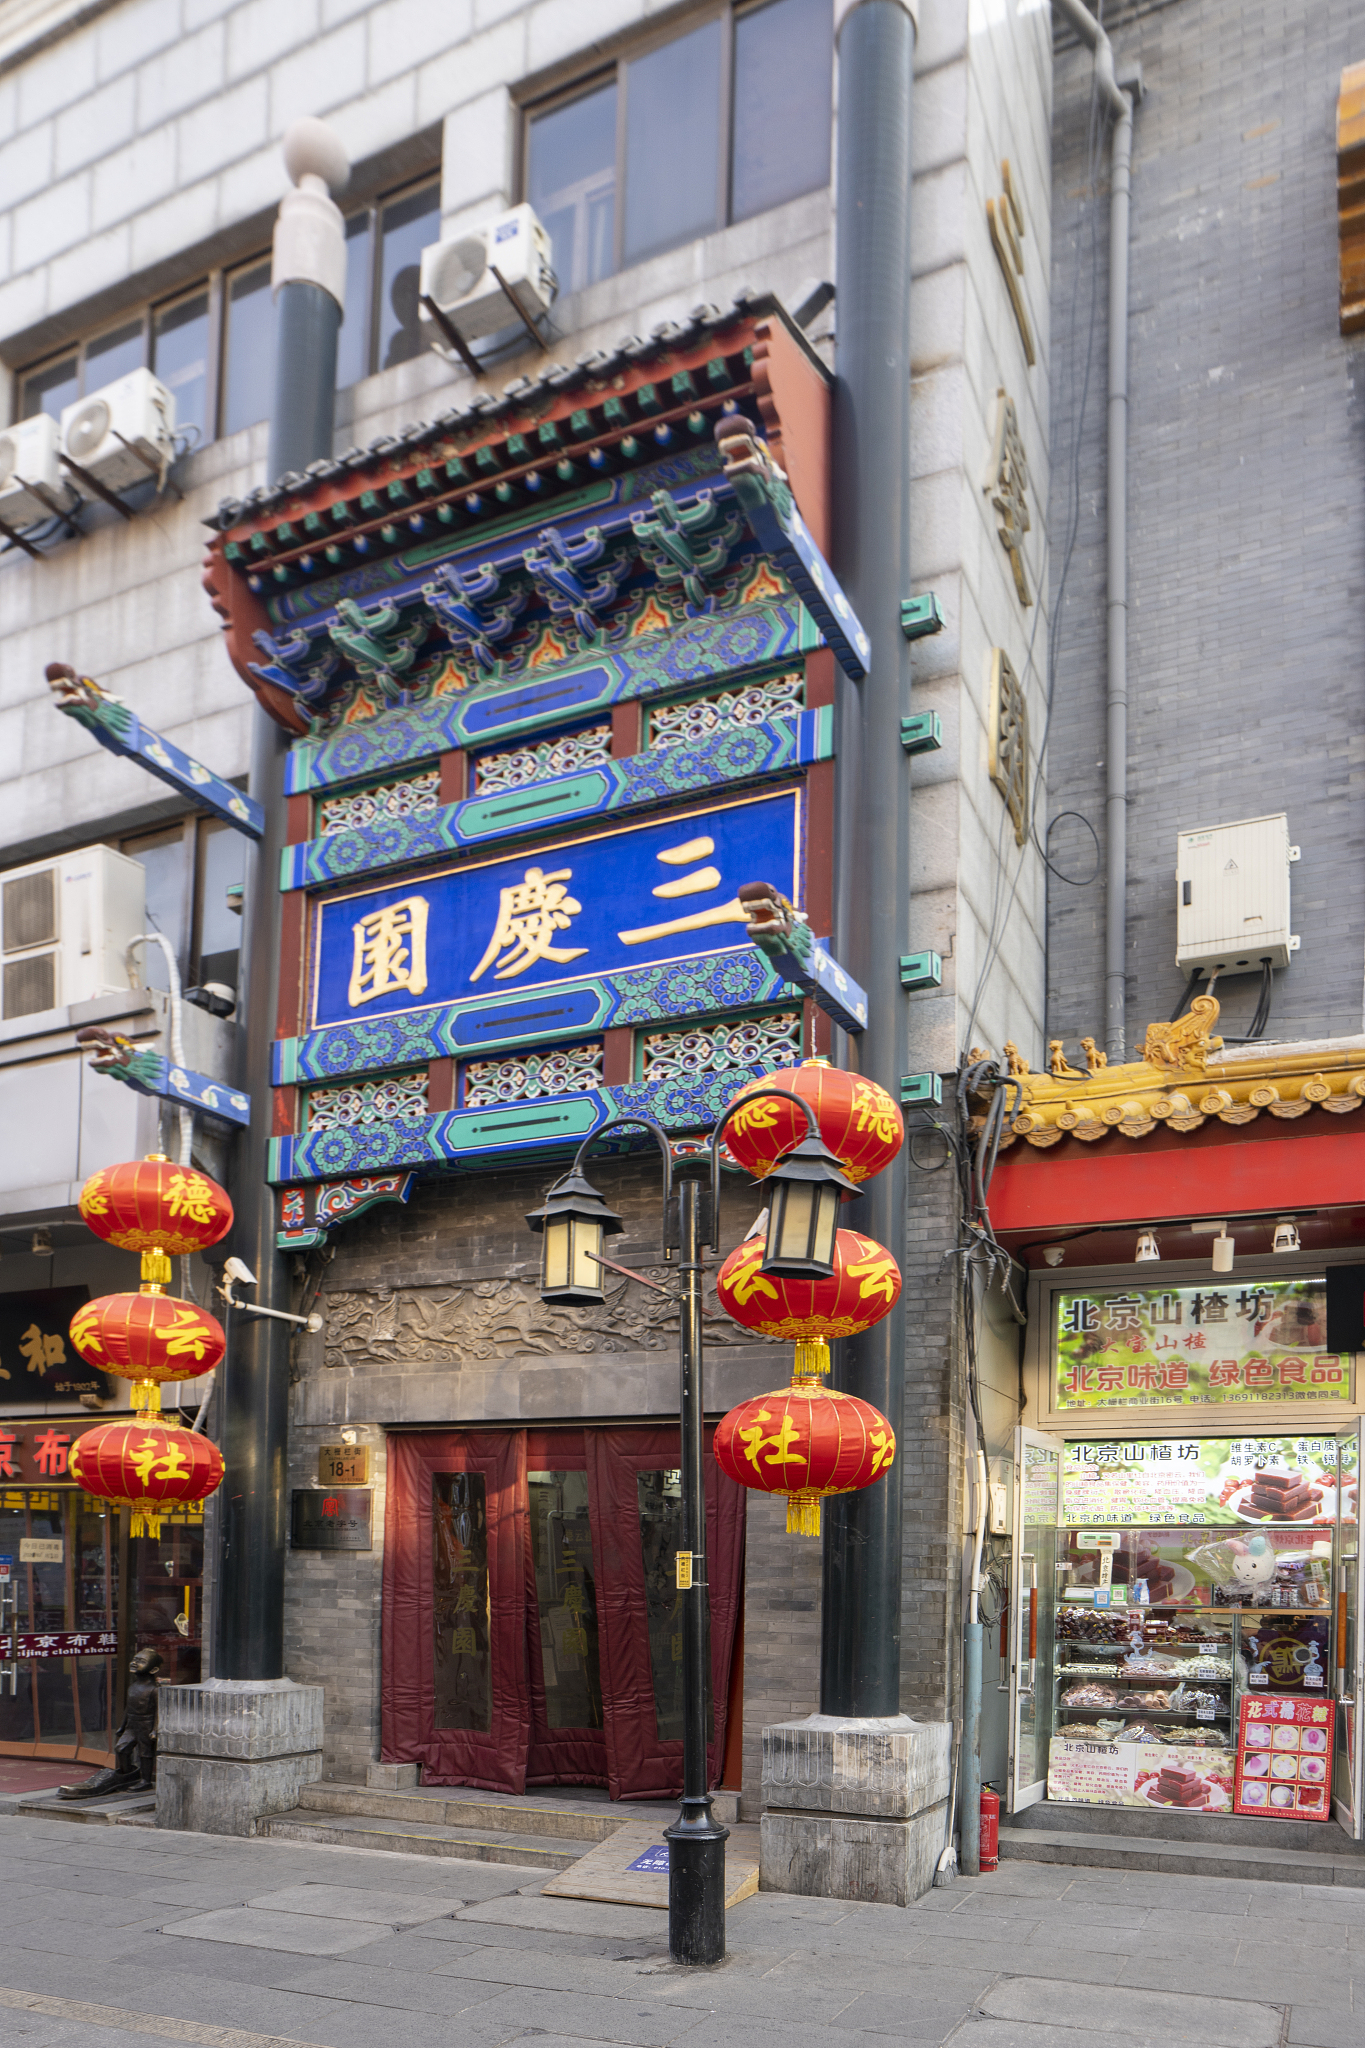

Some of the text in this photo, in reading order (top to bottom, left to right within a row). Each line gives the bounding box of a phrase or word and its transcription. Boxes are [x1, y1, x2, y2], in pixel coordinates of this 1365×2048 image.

[852, 1081, 899, 1144] 德
[162, 1172, 217, 1225] 德
[846, 1240, 896, 1303] 云
[1063, 1287, 1276, 1333] 北京山楂坊
[0, 1323, 67, 1380] 和
[155, 1308, 211, 1361] 云
[1099, 1331, 1207, 1354] 大宝山楂
[1065, 1354, 1343, 1394] 北京味道 绿色食品
[738, 1409, 808, 1475] 社
[1072, 1444, 1200, 1461] 北京山楂坊
[1230, 1442, 1277, 1453] 维生素C
[129, 1438, 190, 1487] 社
[329, 1461, 355, 1477] 18-1
[1065, 1513, 1206, 1523] 北京的味道 绿色食品
[0, 1632, 118, 1650] 北京布鞋
[51, 1646, 81, 1656] cloth
[84, 1645, 116, 1654] shoes
[1246, 1700, 1330, 1723] 花式棉花糖
